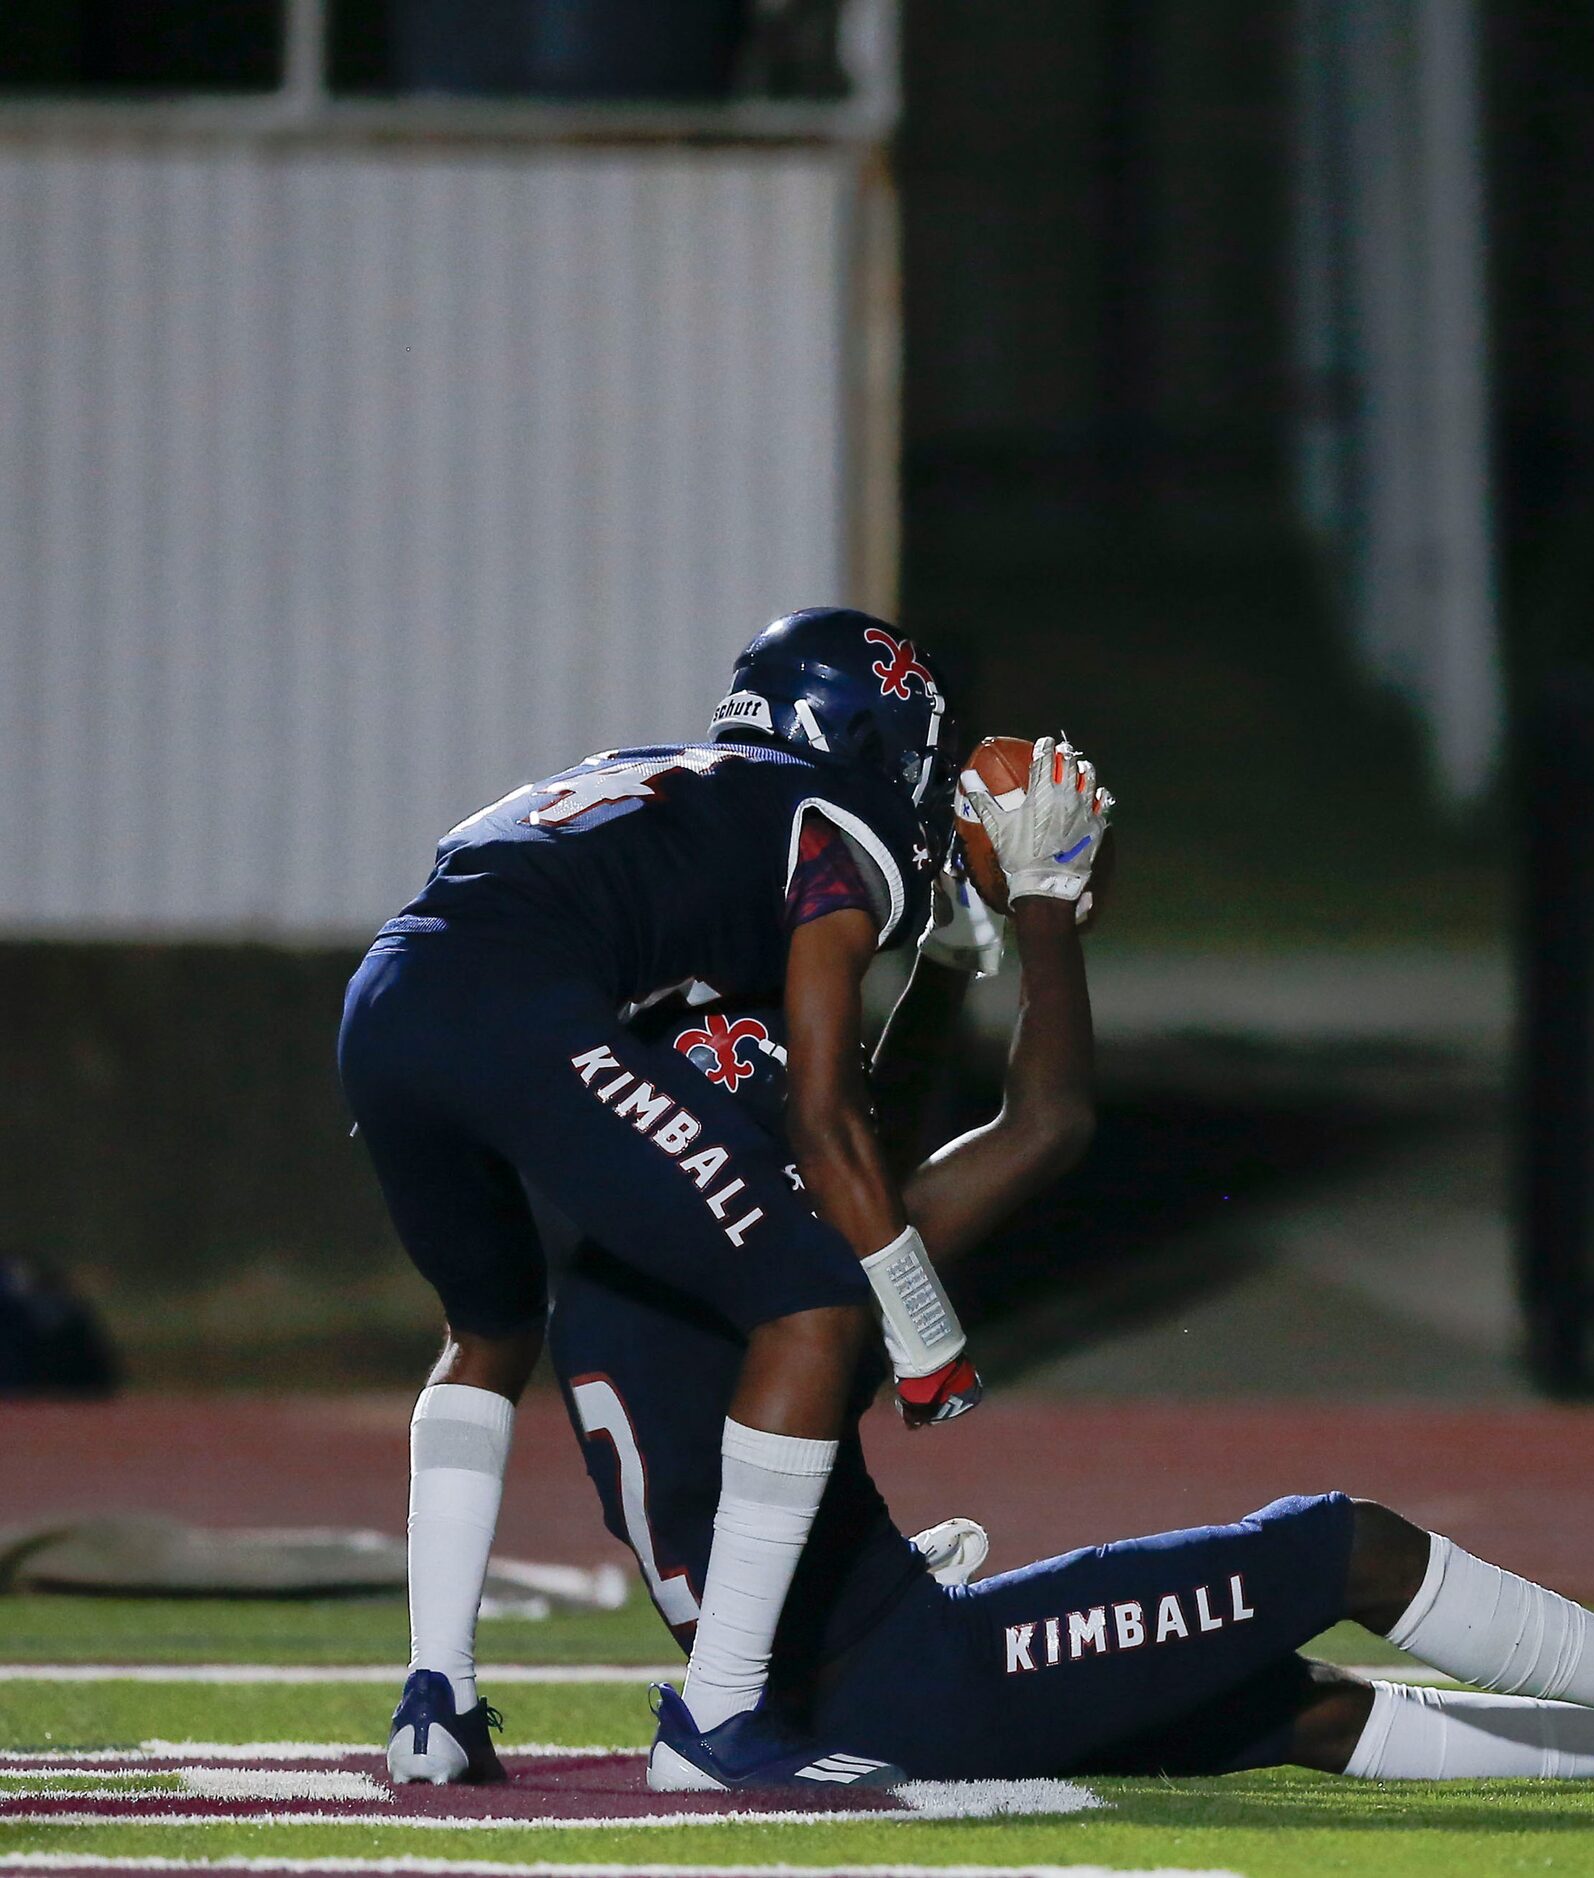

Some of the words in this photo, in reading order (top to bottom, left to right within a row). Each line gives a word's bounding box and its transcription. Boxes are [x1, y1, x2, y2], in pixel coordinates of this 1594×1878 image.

[713, 699, 762, 722] schutt
[570, 1044, 765, 1248] KIMBALL
[1005, 1574, 1256, 1674] KIMBALL
